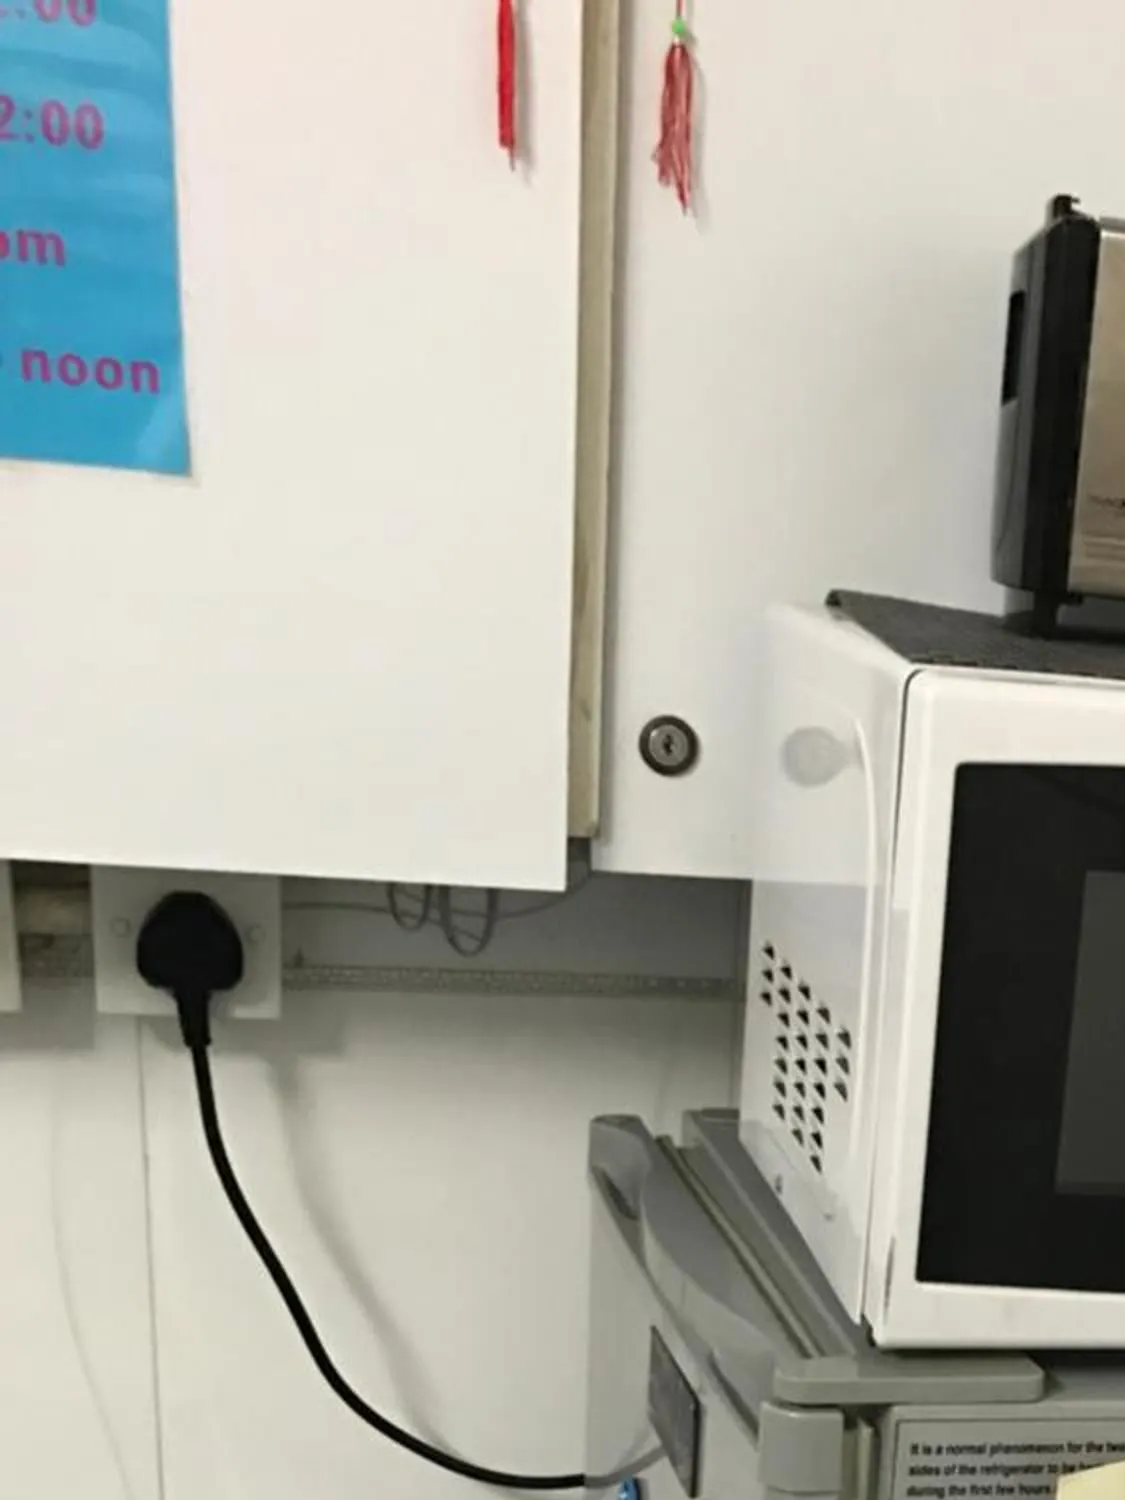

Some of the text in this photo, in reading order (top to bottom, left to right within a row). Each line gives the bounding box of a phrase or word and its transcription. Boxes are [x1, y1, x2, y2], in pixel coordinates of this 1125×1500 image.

[20, 347, 161, 395] noon
[946, 1443, 987, 1455] normal
[1067, 1440, 1083, 1453] for
[1085, 1440, 1104, 1453] the
